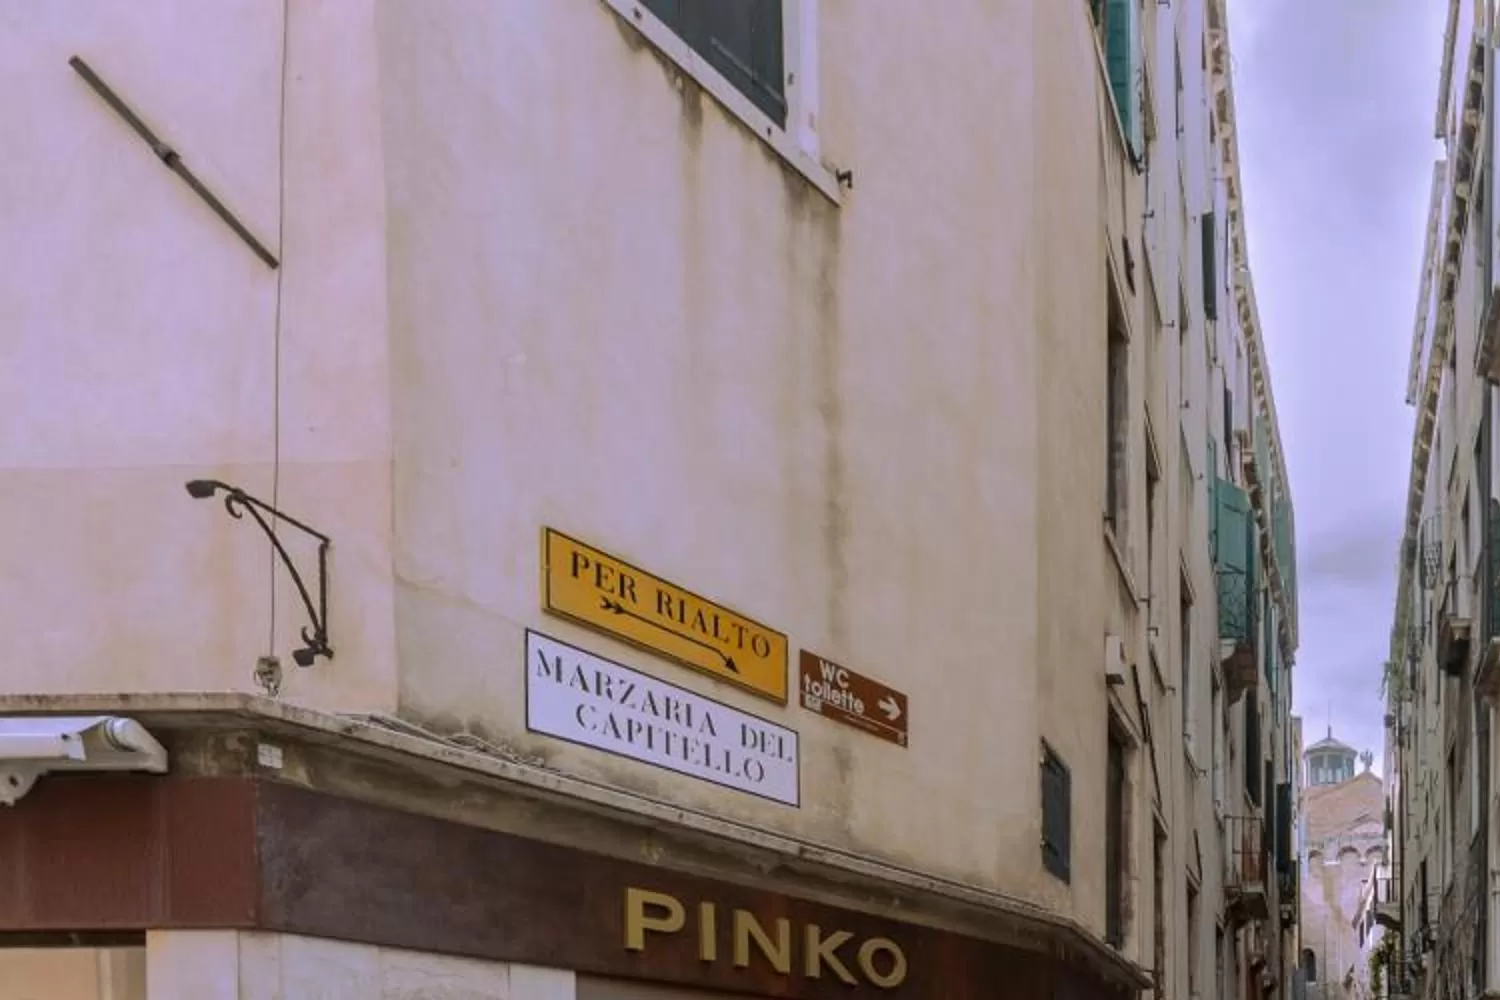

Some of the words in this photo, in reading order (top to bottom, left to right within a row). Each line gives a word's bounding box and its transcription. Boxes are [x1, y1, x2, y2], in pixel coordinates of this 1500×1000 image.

[571, 550, 637, 603] PER
[656, 590, 771, 659] RIALTO
[537, 648, 717, 737] MARZARIA
[740, 723, 793, 763] DEL
[803, 674, 865, 717] toilette
[819, 659, 849, 689] WC
[576, 703, 765, 784] CAPITELLO
[623, 887, 908, 989] PINKO
